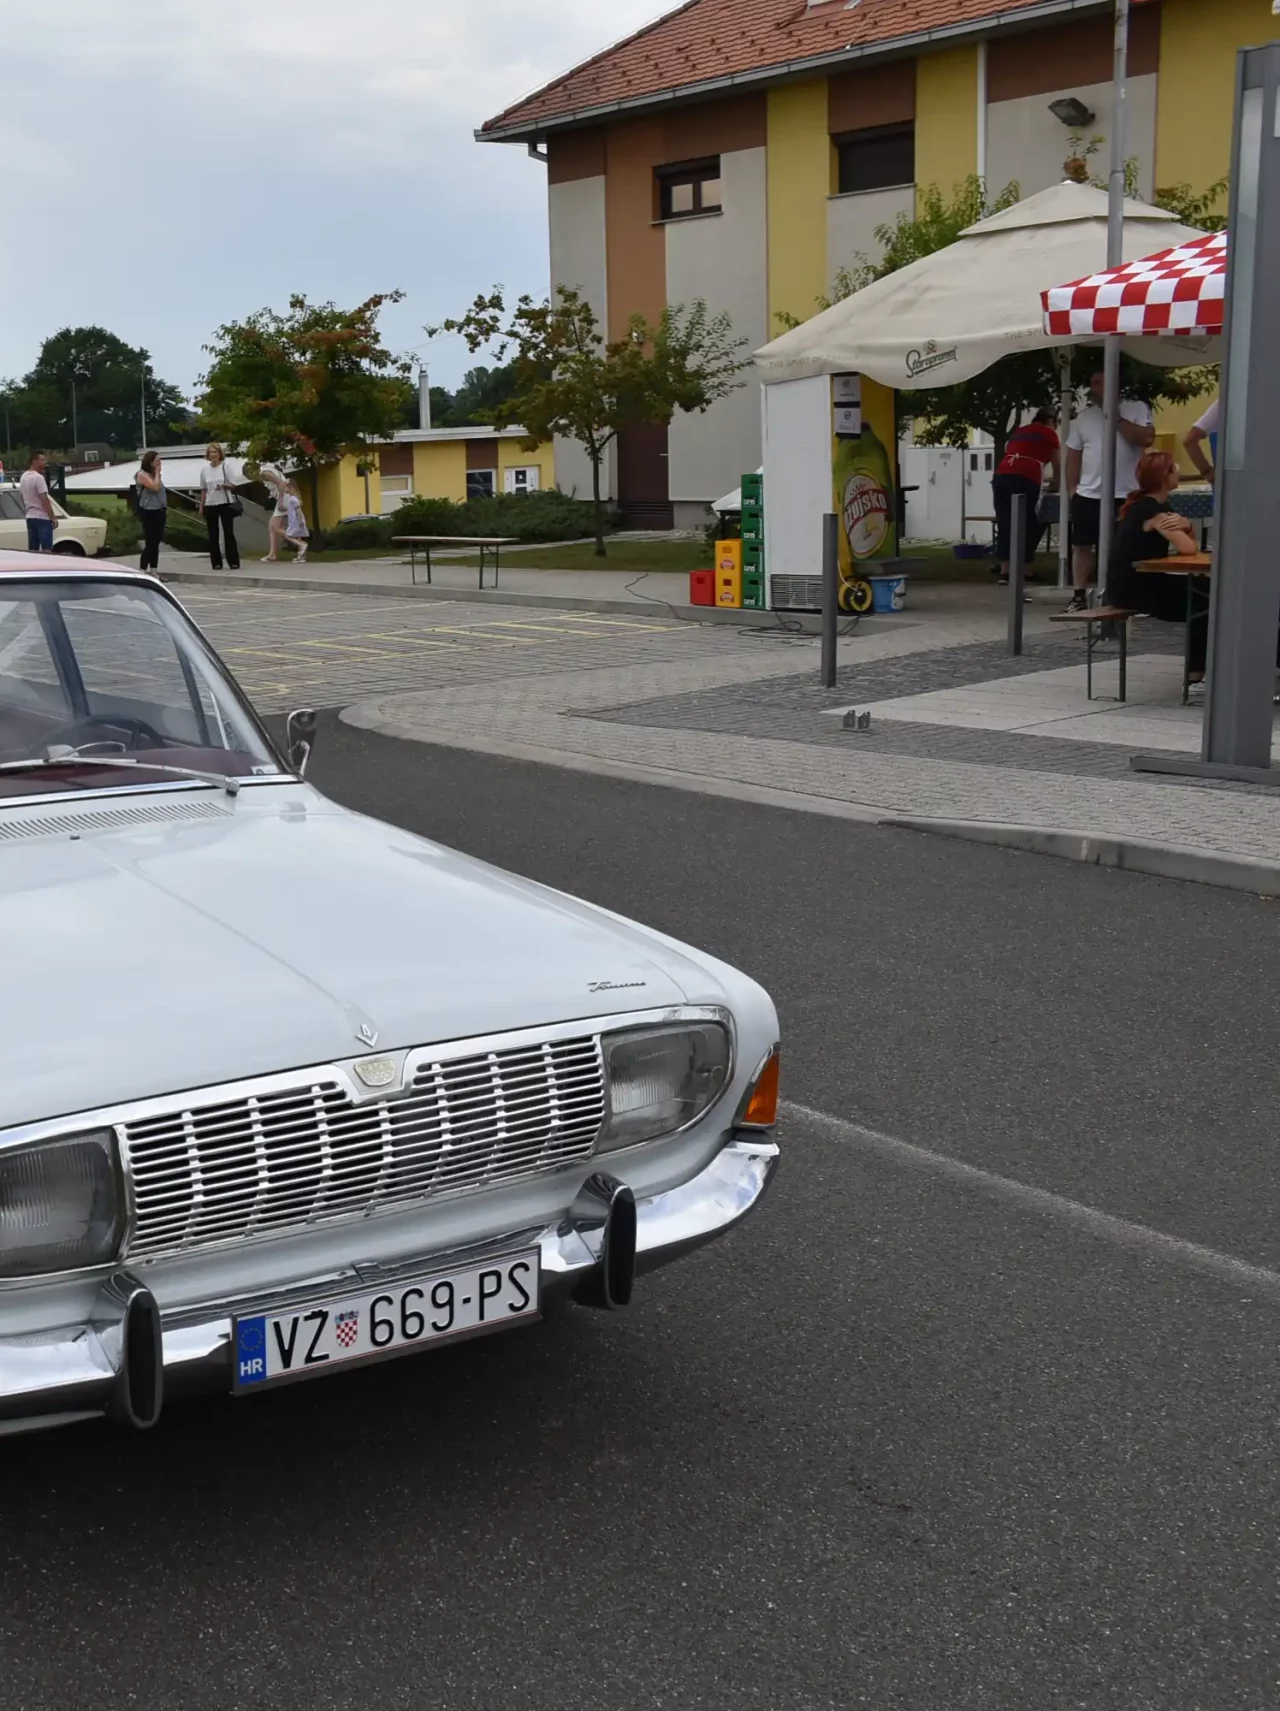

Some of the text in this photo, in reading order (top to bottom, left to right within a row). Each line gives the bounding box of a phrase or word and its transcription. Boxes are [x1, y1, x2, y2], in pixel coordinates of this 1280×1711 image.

[905, 347, 957, 378] Staropramen
[370, 1262, 530, 1347] 669-PS
[240, 1358, 263, 1377] HR
